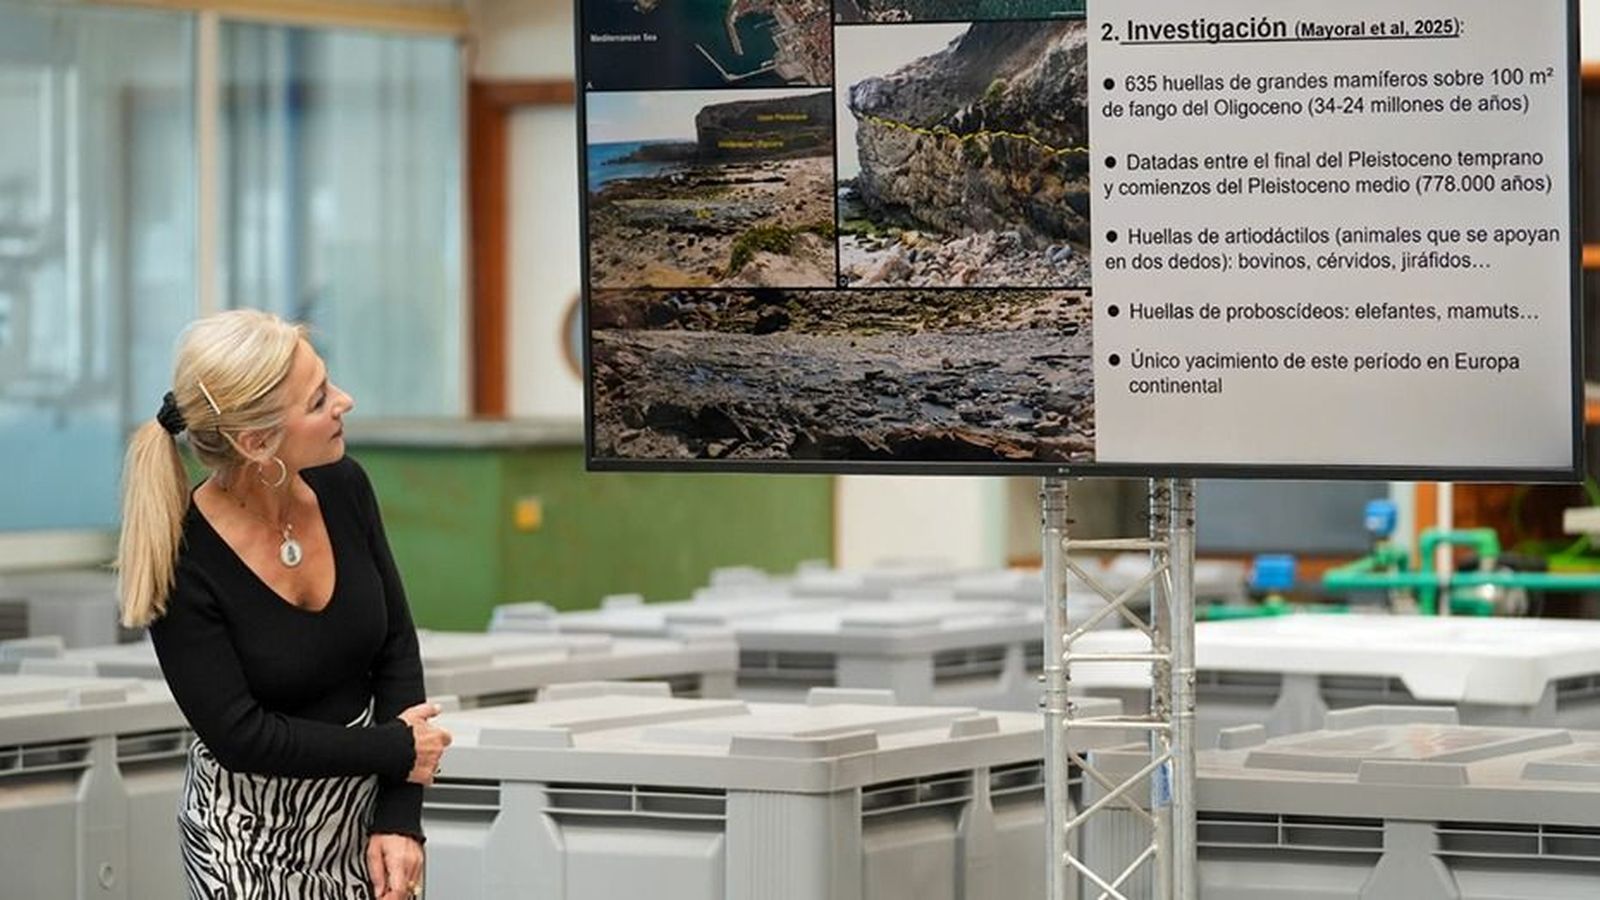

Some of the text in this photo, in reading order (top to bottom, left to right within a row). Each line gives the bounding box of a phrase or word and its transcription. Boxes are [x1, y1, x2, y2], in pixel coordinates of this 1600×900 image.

[1101, 23, 1119, 42] 2.
[1127, 18, 1287, 43] Investigación
[1295, 20, 1366, 40] (Mayoral
[1370, 22, 1386, 37] et
[1414, 17, 1464, 37] 2025):
[1124, 67, 1554, 95] 635 huellas de grandes mamíferos sobre 100 m²
[1101, 94, 1530, 122] de fango del Oligoceno (34-24 millones de años)
[1126, 151, 1544, 172] Datadas entre el final del Pleistoceno temprano
[1103, 174, 1553, 201] y comienzos del Pleistoceno medio (778.000 años)
[1127, 226, 1560, 248] Huellas de artiodáctilos (animales que se apoyan
[1104, 257, 1127, 271] en
[1131, 253, 1164, 271] dos
[1167, 253, 1233, 273] dedos):
[1237, 253, 1311, 271] bovinos,
[1316, 252, 1397, 271] cérvidos,
[1129, 303, 1195, 320] Huellas
[1198, 303, 1222, 320] de
[1225, 303, 1350, 324] proboscídeos:
[1354, 302, 1442, 322] elefantes,
[1130, 348, 1520, 374] Único yacimiento de este período en Europa
[1128, 377, 1223, 395] continental
